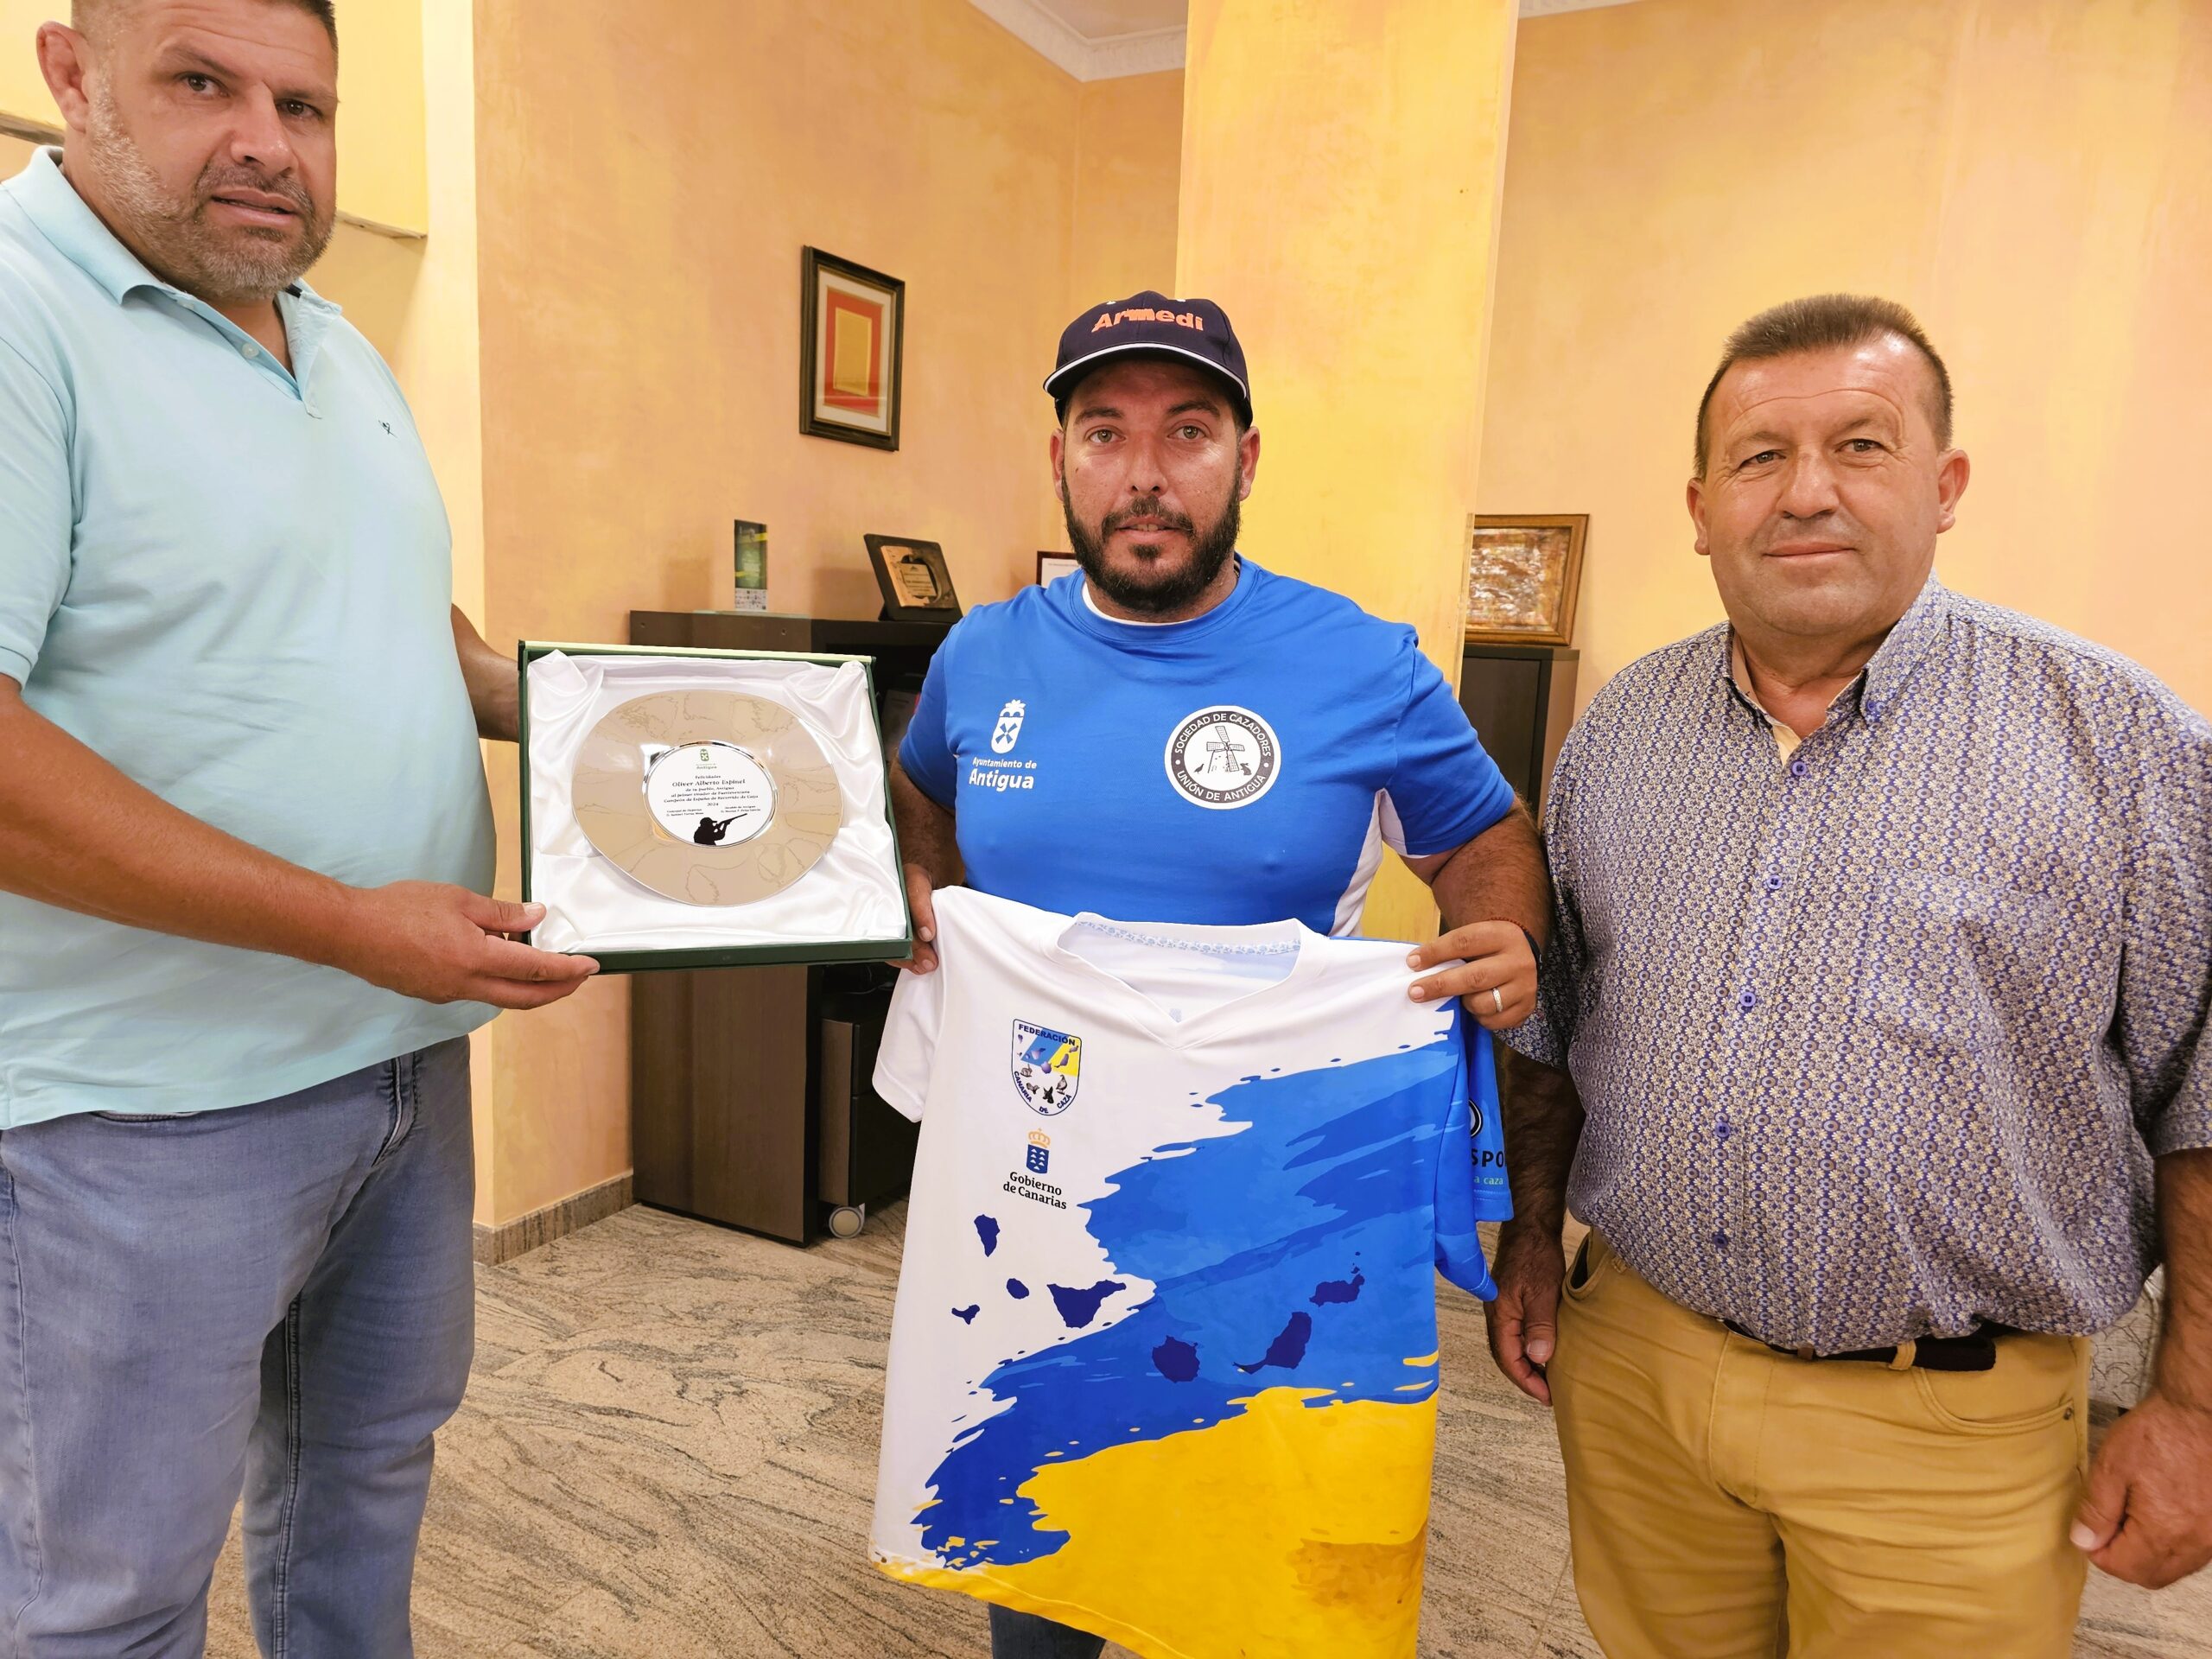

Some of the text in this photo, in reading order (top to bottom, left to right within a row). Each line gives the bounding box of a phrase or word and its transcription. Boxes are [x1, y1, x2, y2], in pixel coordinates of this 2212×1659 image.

[1091, 308, 1204, 333] Armedi
[1175, 713, 1272, 757] SOCIEDAD DE CAZADORES
[972, 757, 1037, 769] Ayuntamiento de
[969, 767, 1034, 792] Antigua
[1177, 770, 1267, 802] UNIÓN DE ANTIGUA
[1018, 1023, 1076, 1046] FEDERACIÓN
[1014, 1071, 1033, 1103] CANARIA
[1056, 1094, 1072, 1109] CAZA
[1003, 1180, 1067, 1210] de Canarias
[1009, 1171, 1062, 1196] Gobierno
